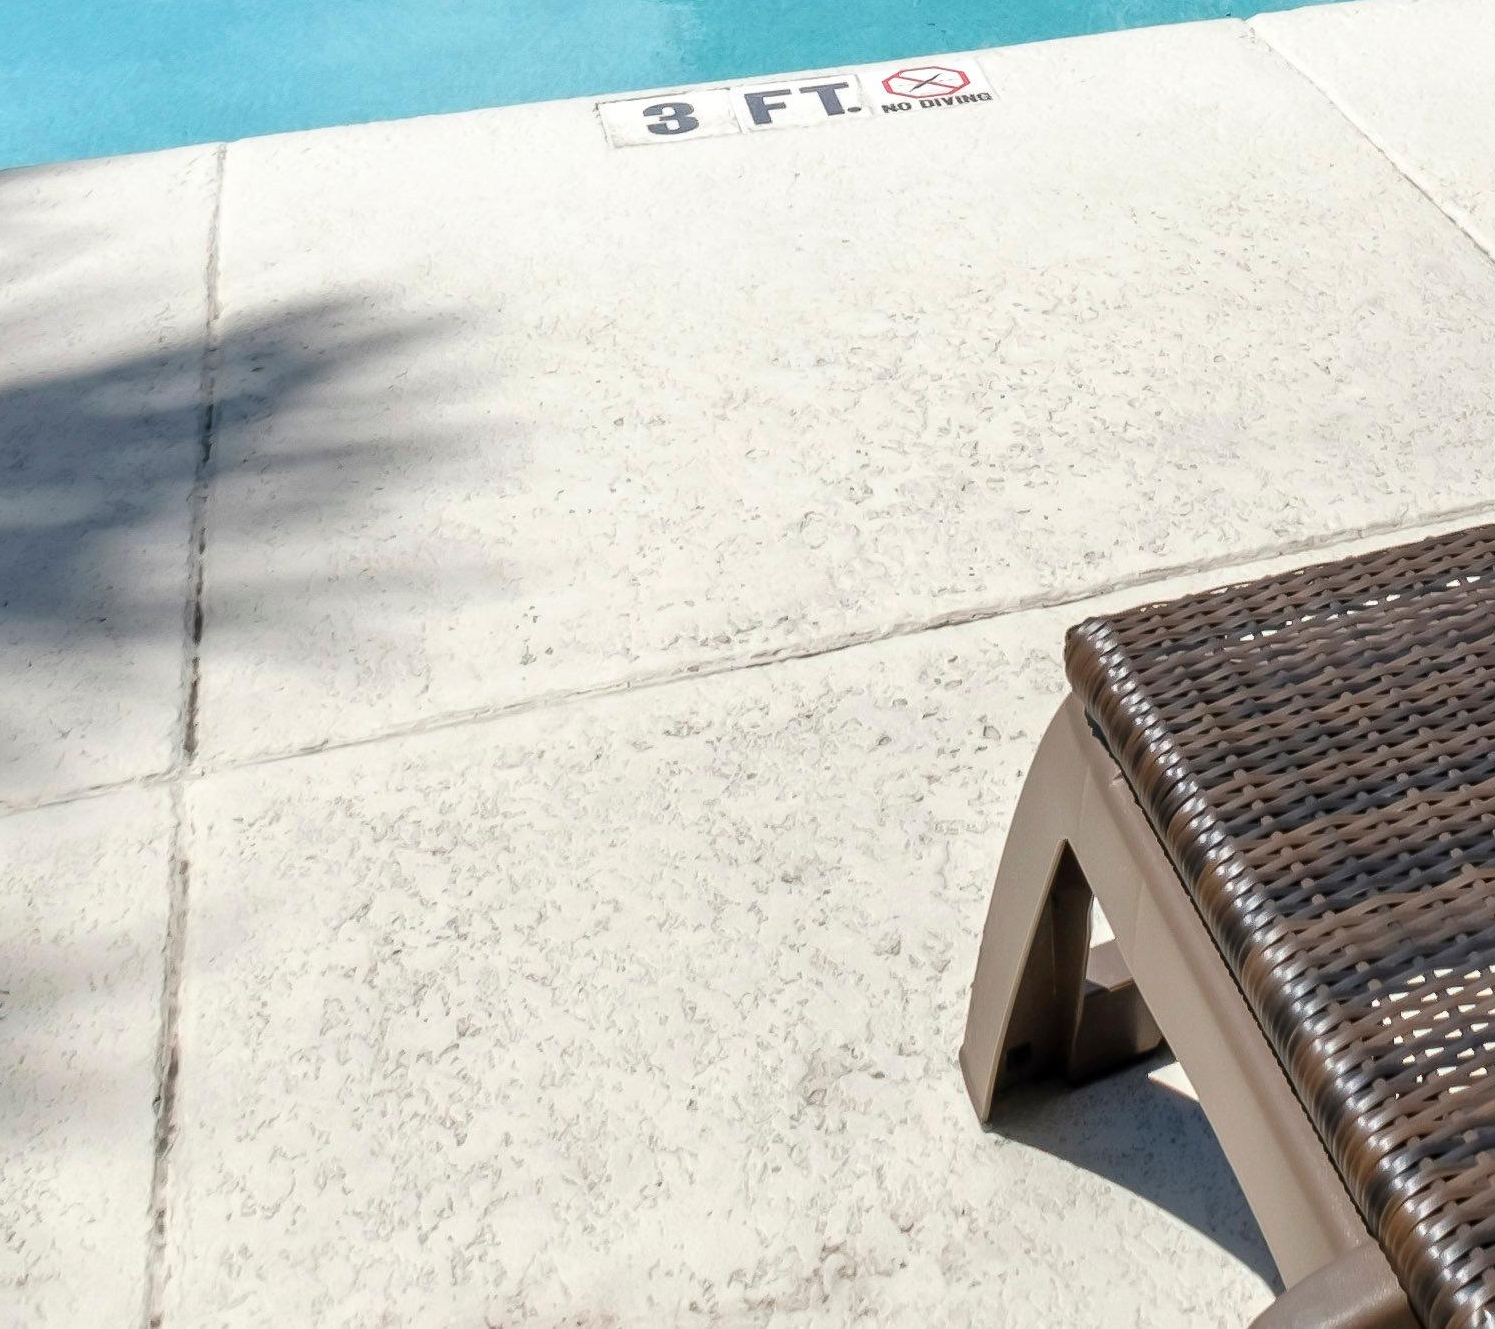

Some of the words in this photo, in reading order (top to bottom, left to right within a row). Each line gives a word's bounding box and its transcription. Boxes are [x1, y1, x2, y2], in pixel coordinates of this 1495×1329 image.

[642, 101, 701, 136] 3
[743, 81, 862, 126] FT.
[881, 101, 913, 114] NO
[921, 91, 994, 110] DIVING
